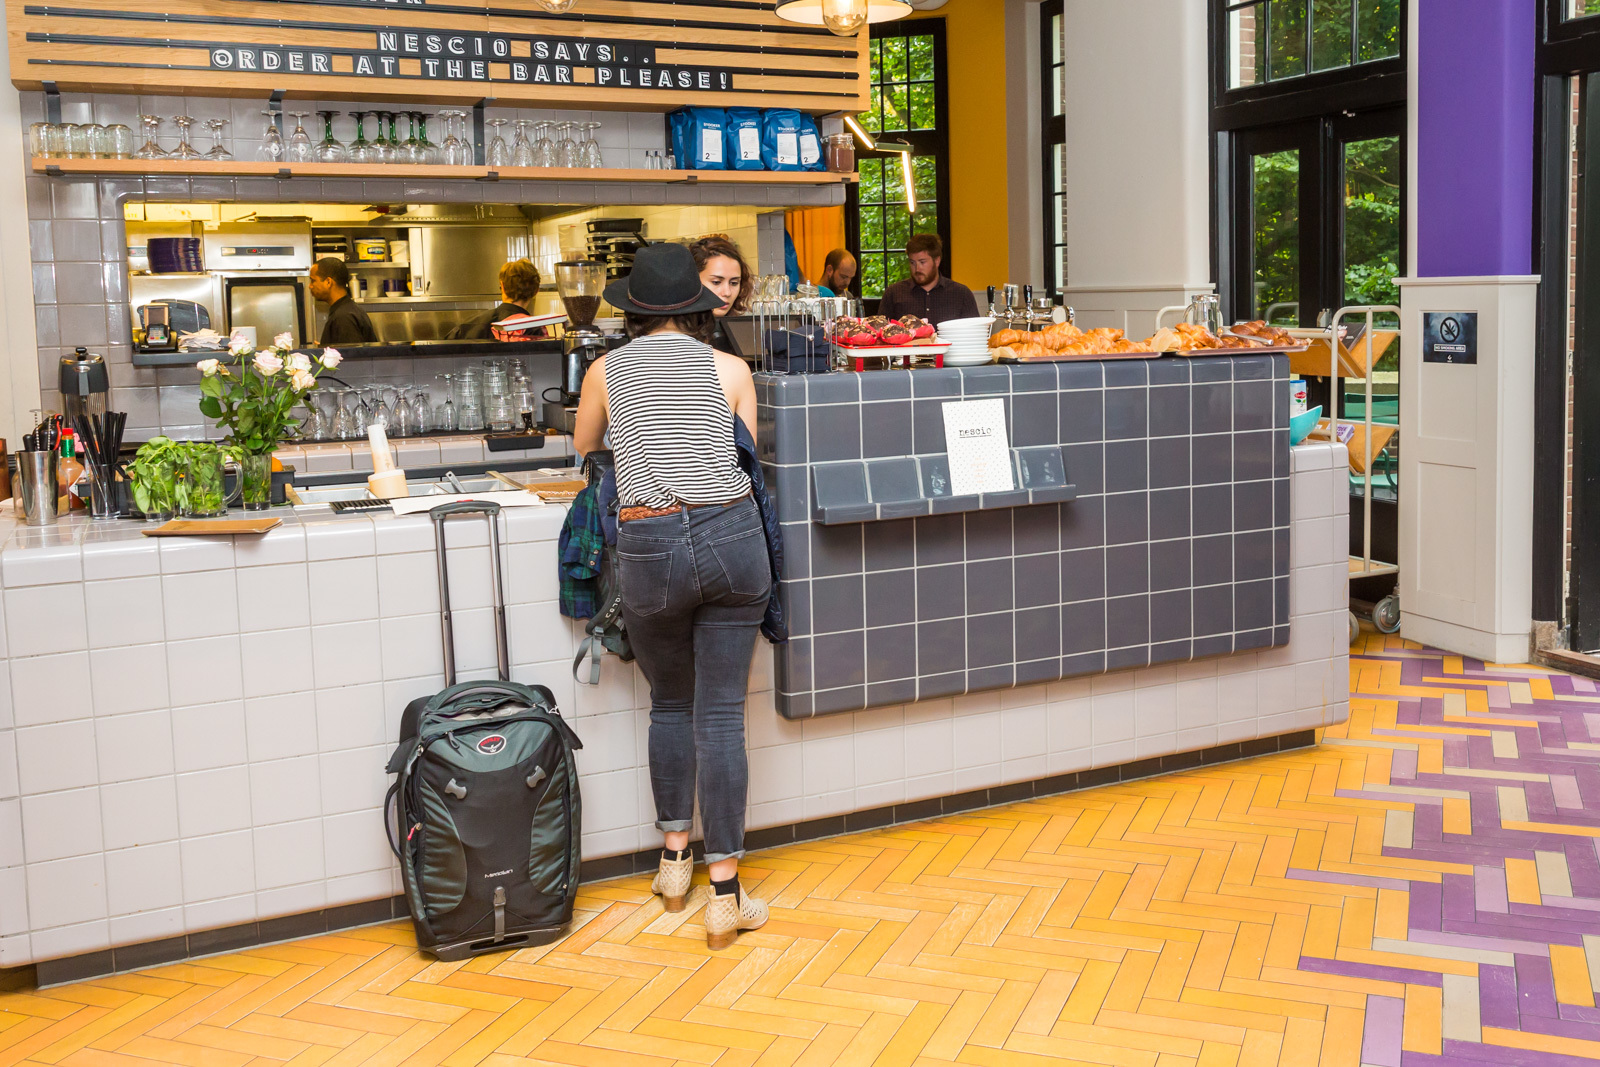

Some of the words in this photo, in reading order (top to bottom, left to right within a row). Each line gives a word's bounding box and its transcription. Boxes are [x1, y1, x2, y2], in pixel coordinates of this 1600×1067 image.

[380, 32, 508, 57] NESCIO
[211, 48, 329, 72] ORDER
[356, 56, 395, 75] AT
[425, 58, 485, 79] THE
[513, 63, 571, 83] BAR
[598, 67, 727, 90] PLEASE!
[958, 427, 992, 436] nescio
